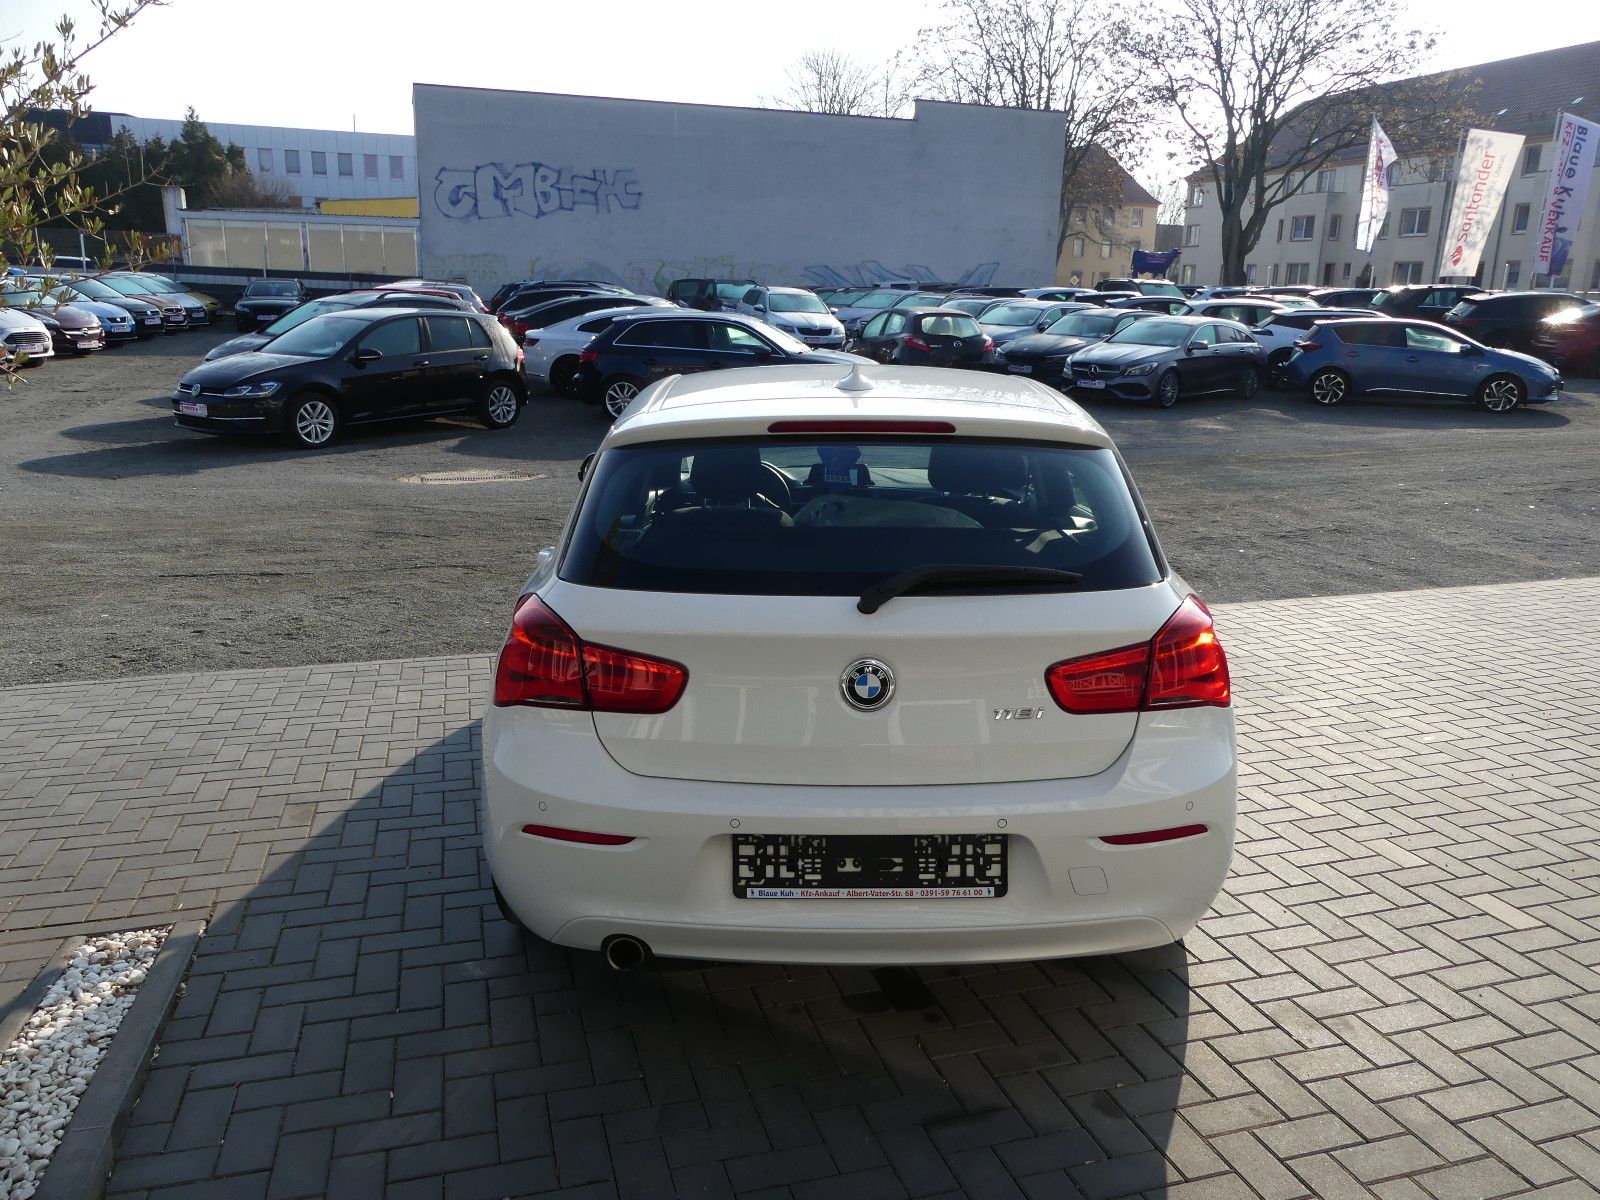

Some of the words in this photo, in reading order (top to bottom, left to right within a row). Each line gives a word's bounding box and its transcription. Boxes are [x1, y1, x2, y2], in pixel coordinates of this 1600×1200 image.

[1562, 121, 1574, 145] KFZ
[1565, 125, 1588, 180] Blaue
[1456, 151, 1496, 243] Santander
[1539, 200, 1559, 262] VERKAUF
[850, 666, 886, 680] BMW
[846, 889, 903, 897] Albert-Vater-Str.
[904, 889, 914, 897] 68
[920, 889, 950, 897] 0391-59
